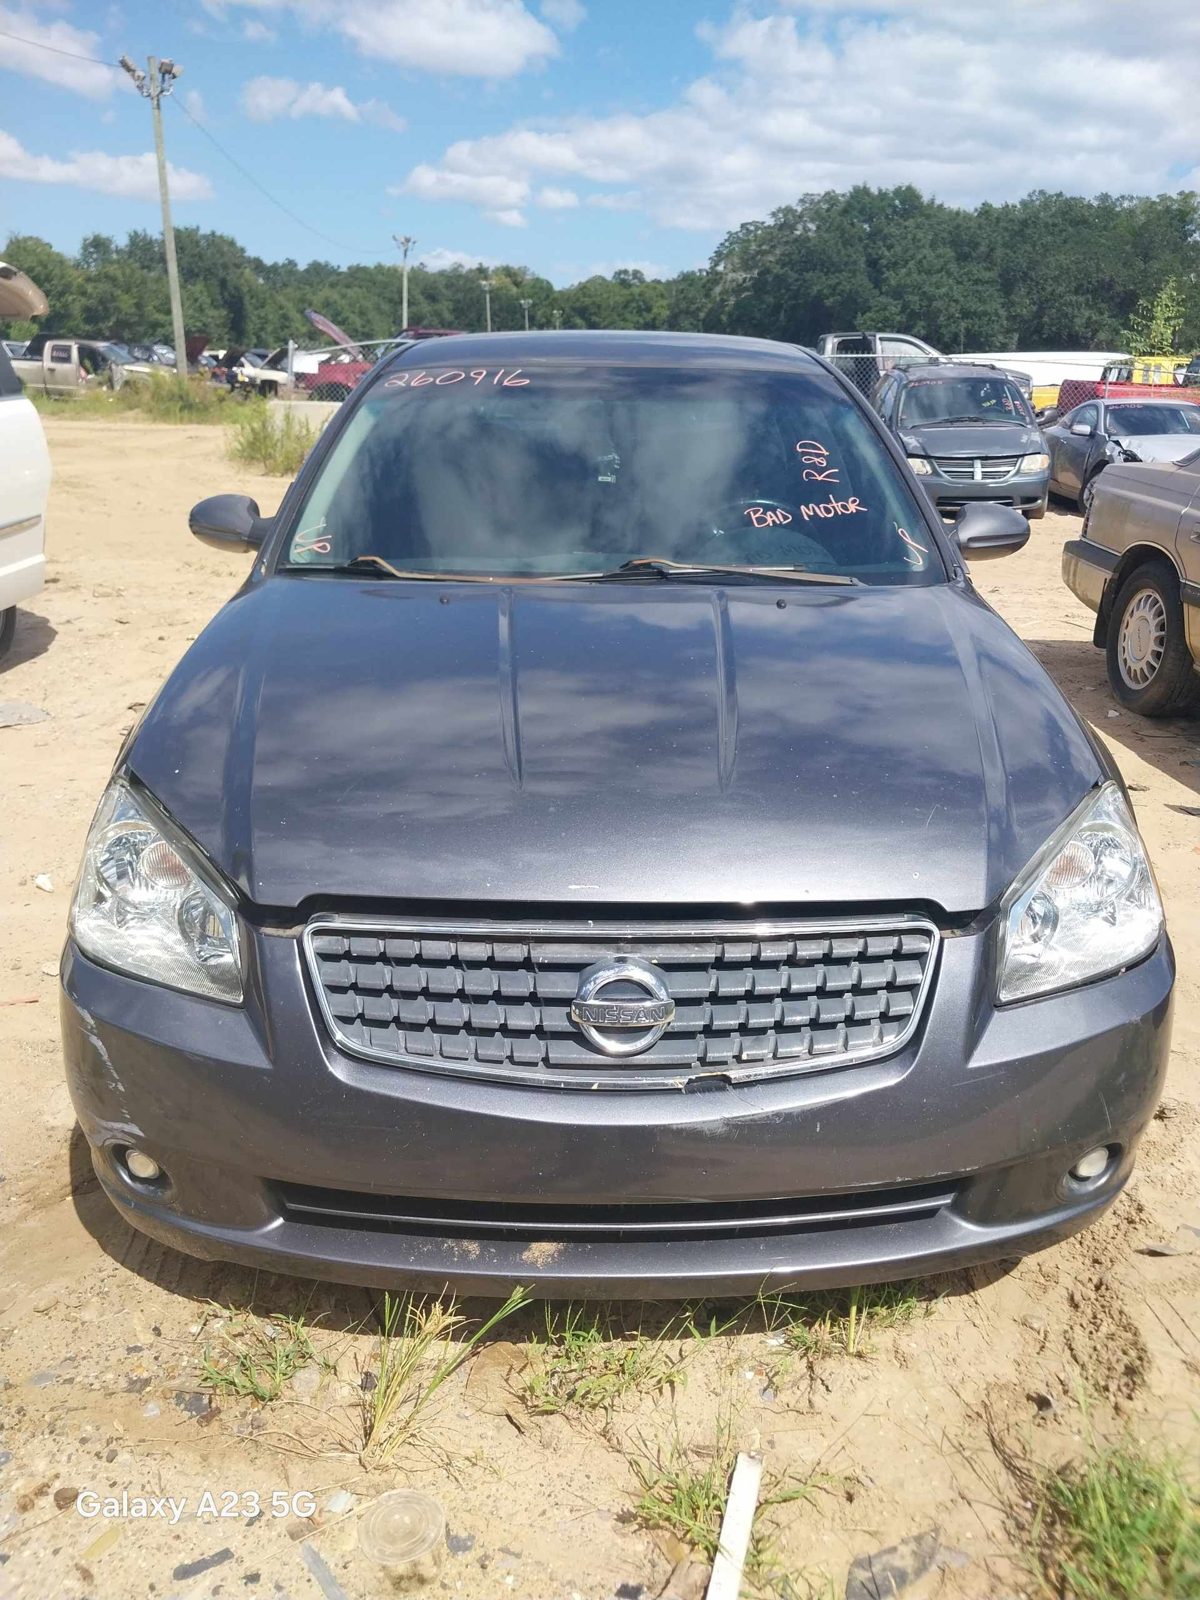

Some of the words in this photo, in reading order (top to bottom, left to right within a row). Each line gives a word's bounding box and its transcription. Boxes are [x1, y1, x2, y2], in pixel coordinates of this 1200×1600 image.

[384, 368, 531, 388] 260916
[744, 507, 793, 528] BAD
[582, 1006, 667, 1023] NISSAN
